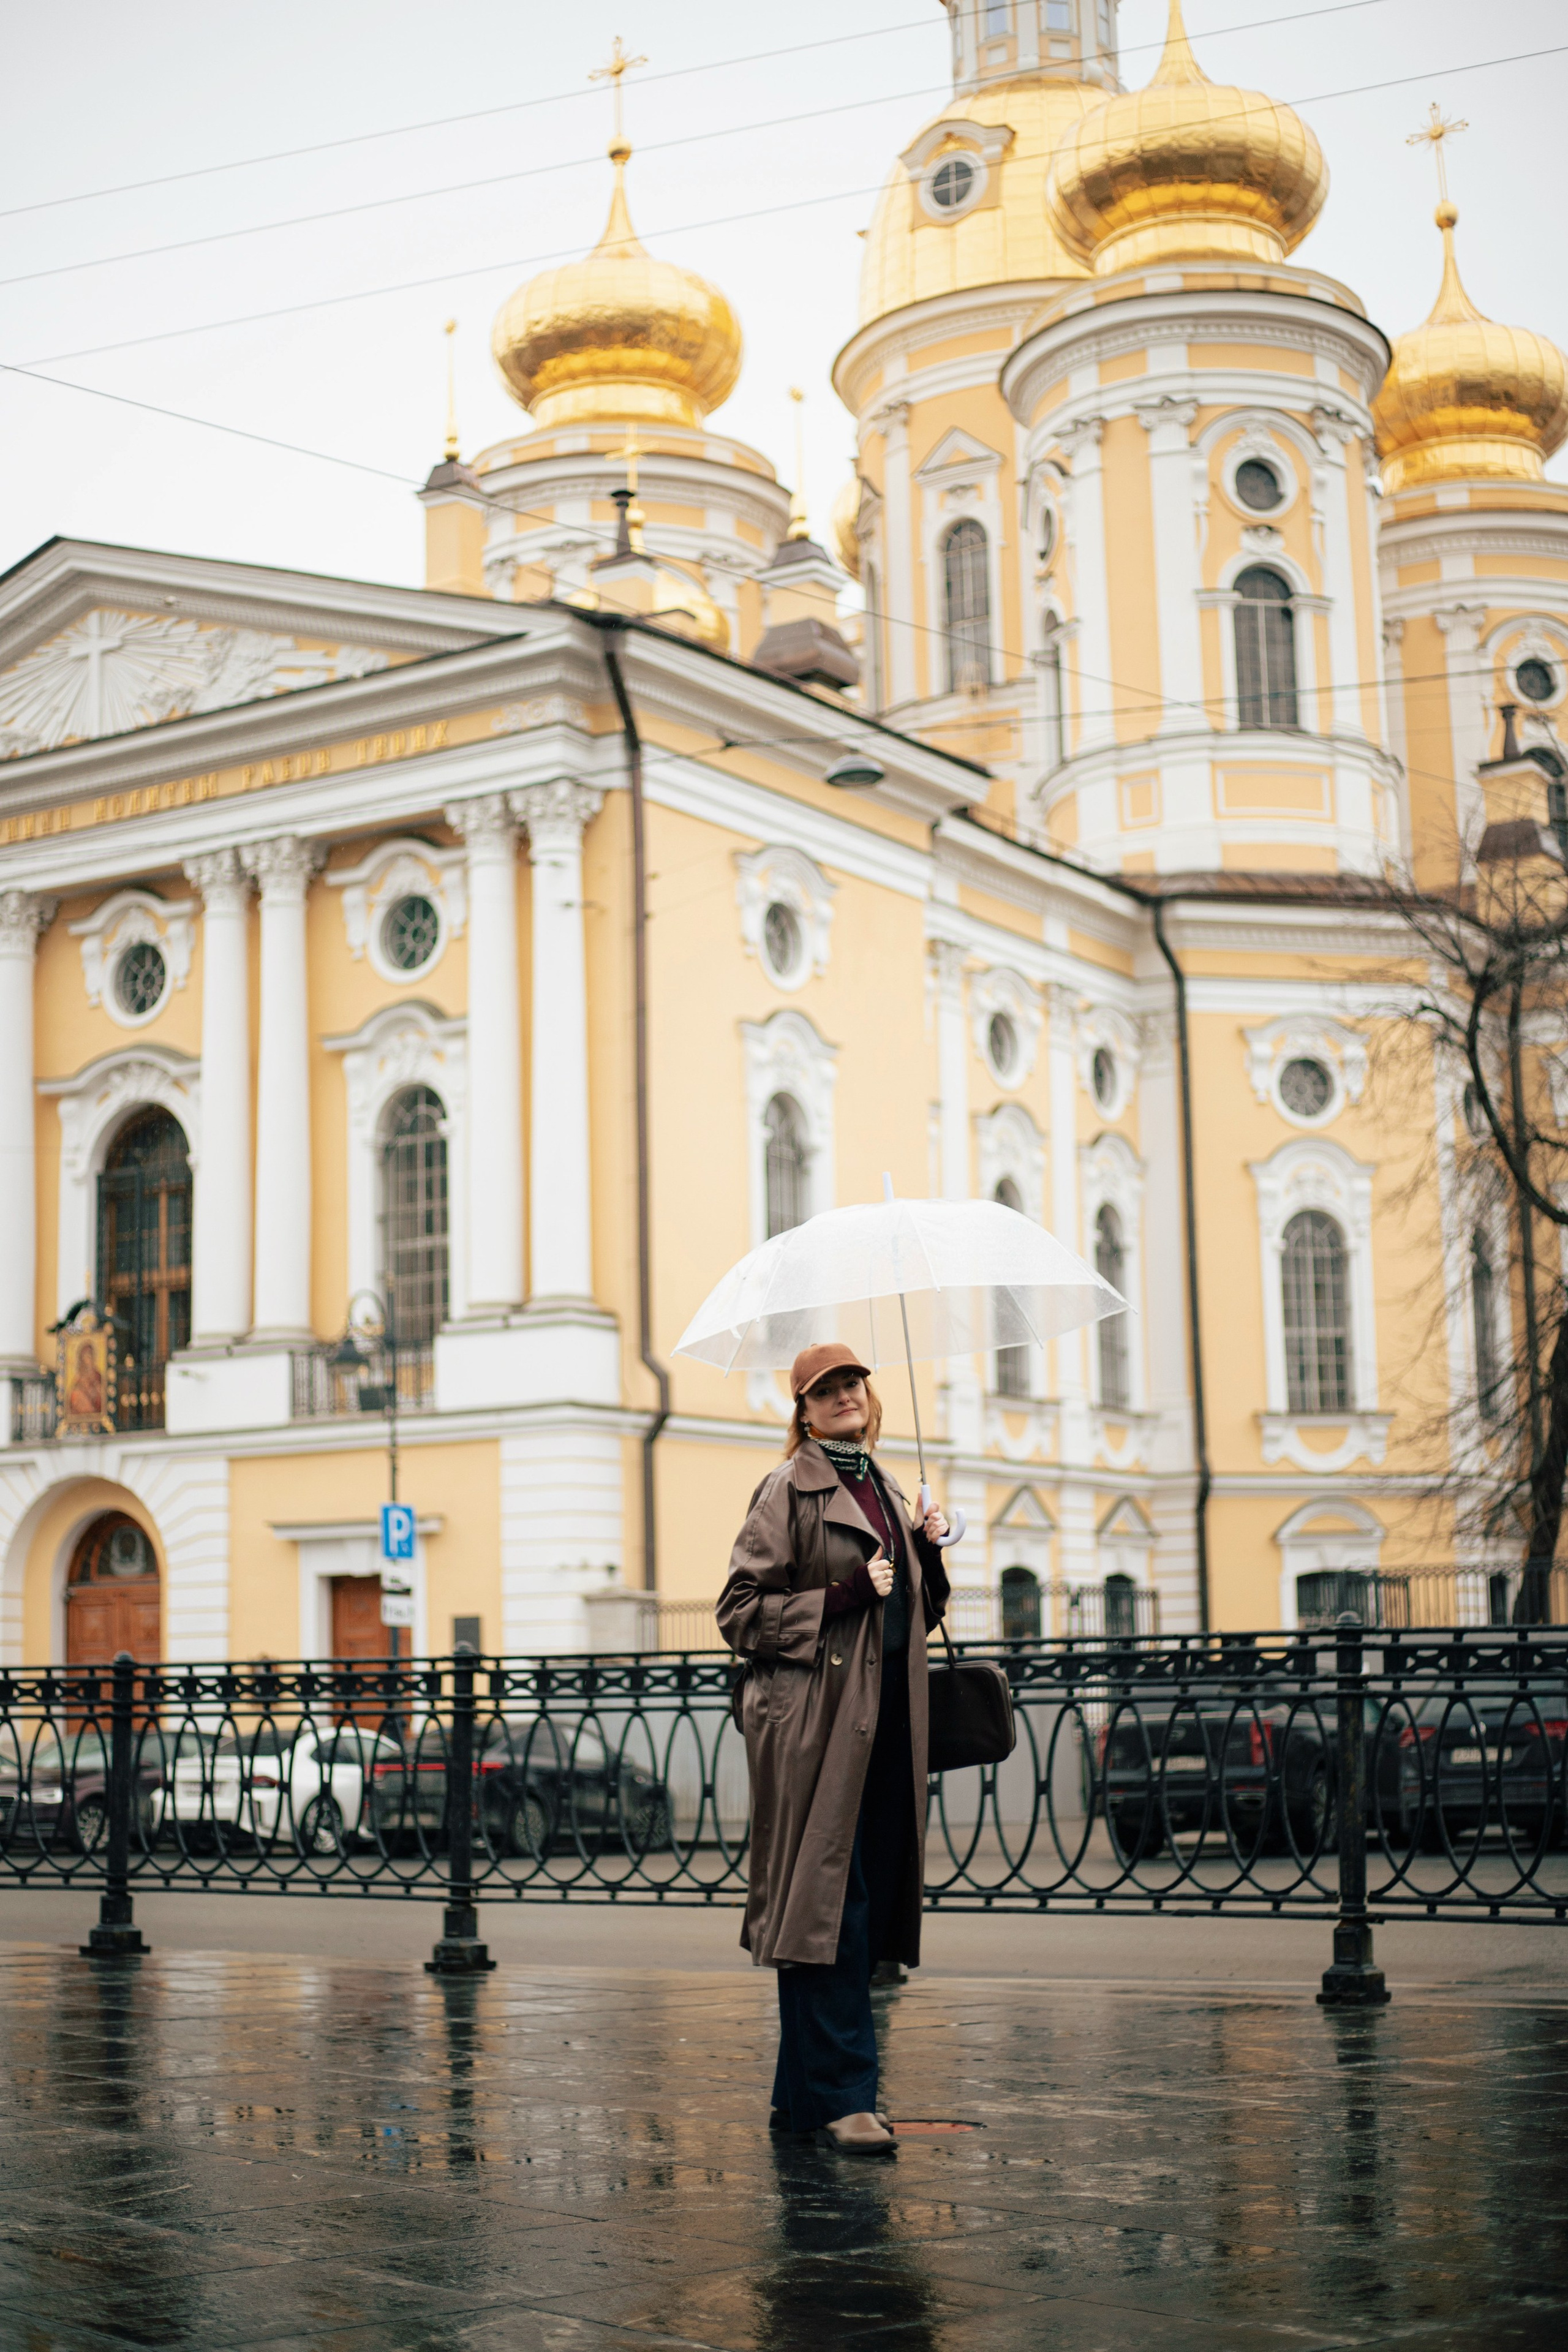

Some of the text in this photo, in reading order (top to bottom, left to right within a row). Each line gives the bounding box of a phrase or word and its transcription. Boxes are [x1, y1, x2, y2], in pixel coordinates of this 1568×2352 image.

[243, 748, 330, 788] РАБОВ
[354, 719, 448, 764] ТВОИХ
[388, 1508, 410, 1555] P
